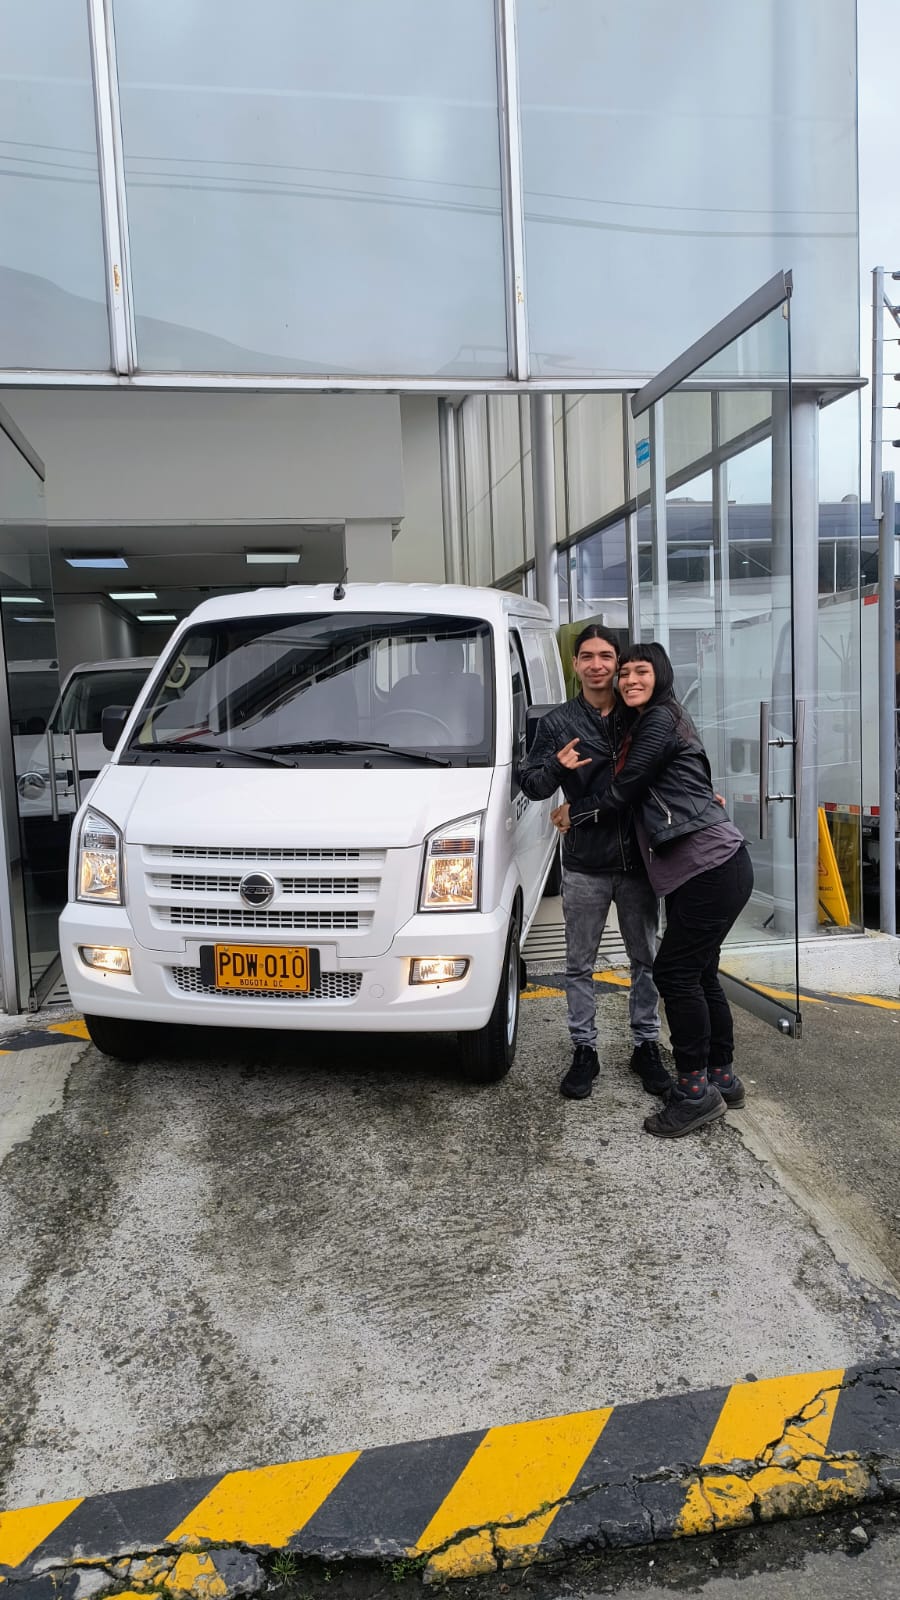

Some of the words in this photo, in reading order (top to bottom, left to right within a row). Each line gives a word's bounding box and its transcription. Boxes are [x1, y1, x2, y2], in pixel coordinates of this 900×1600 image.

[219, 952, 258, 977] PDW
[264, 954, 305, 978] 010
[239, 978, 268, 987] BOGOTA
